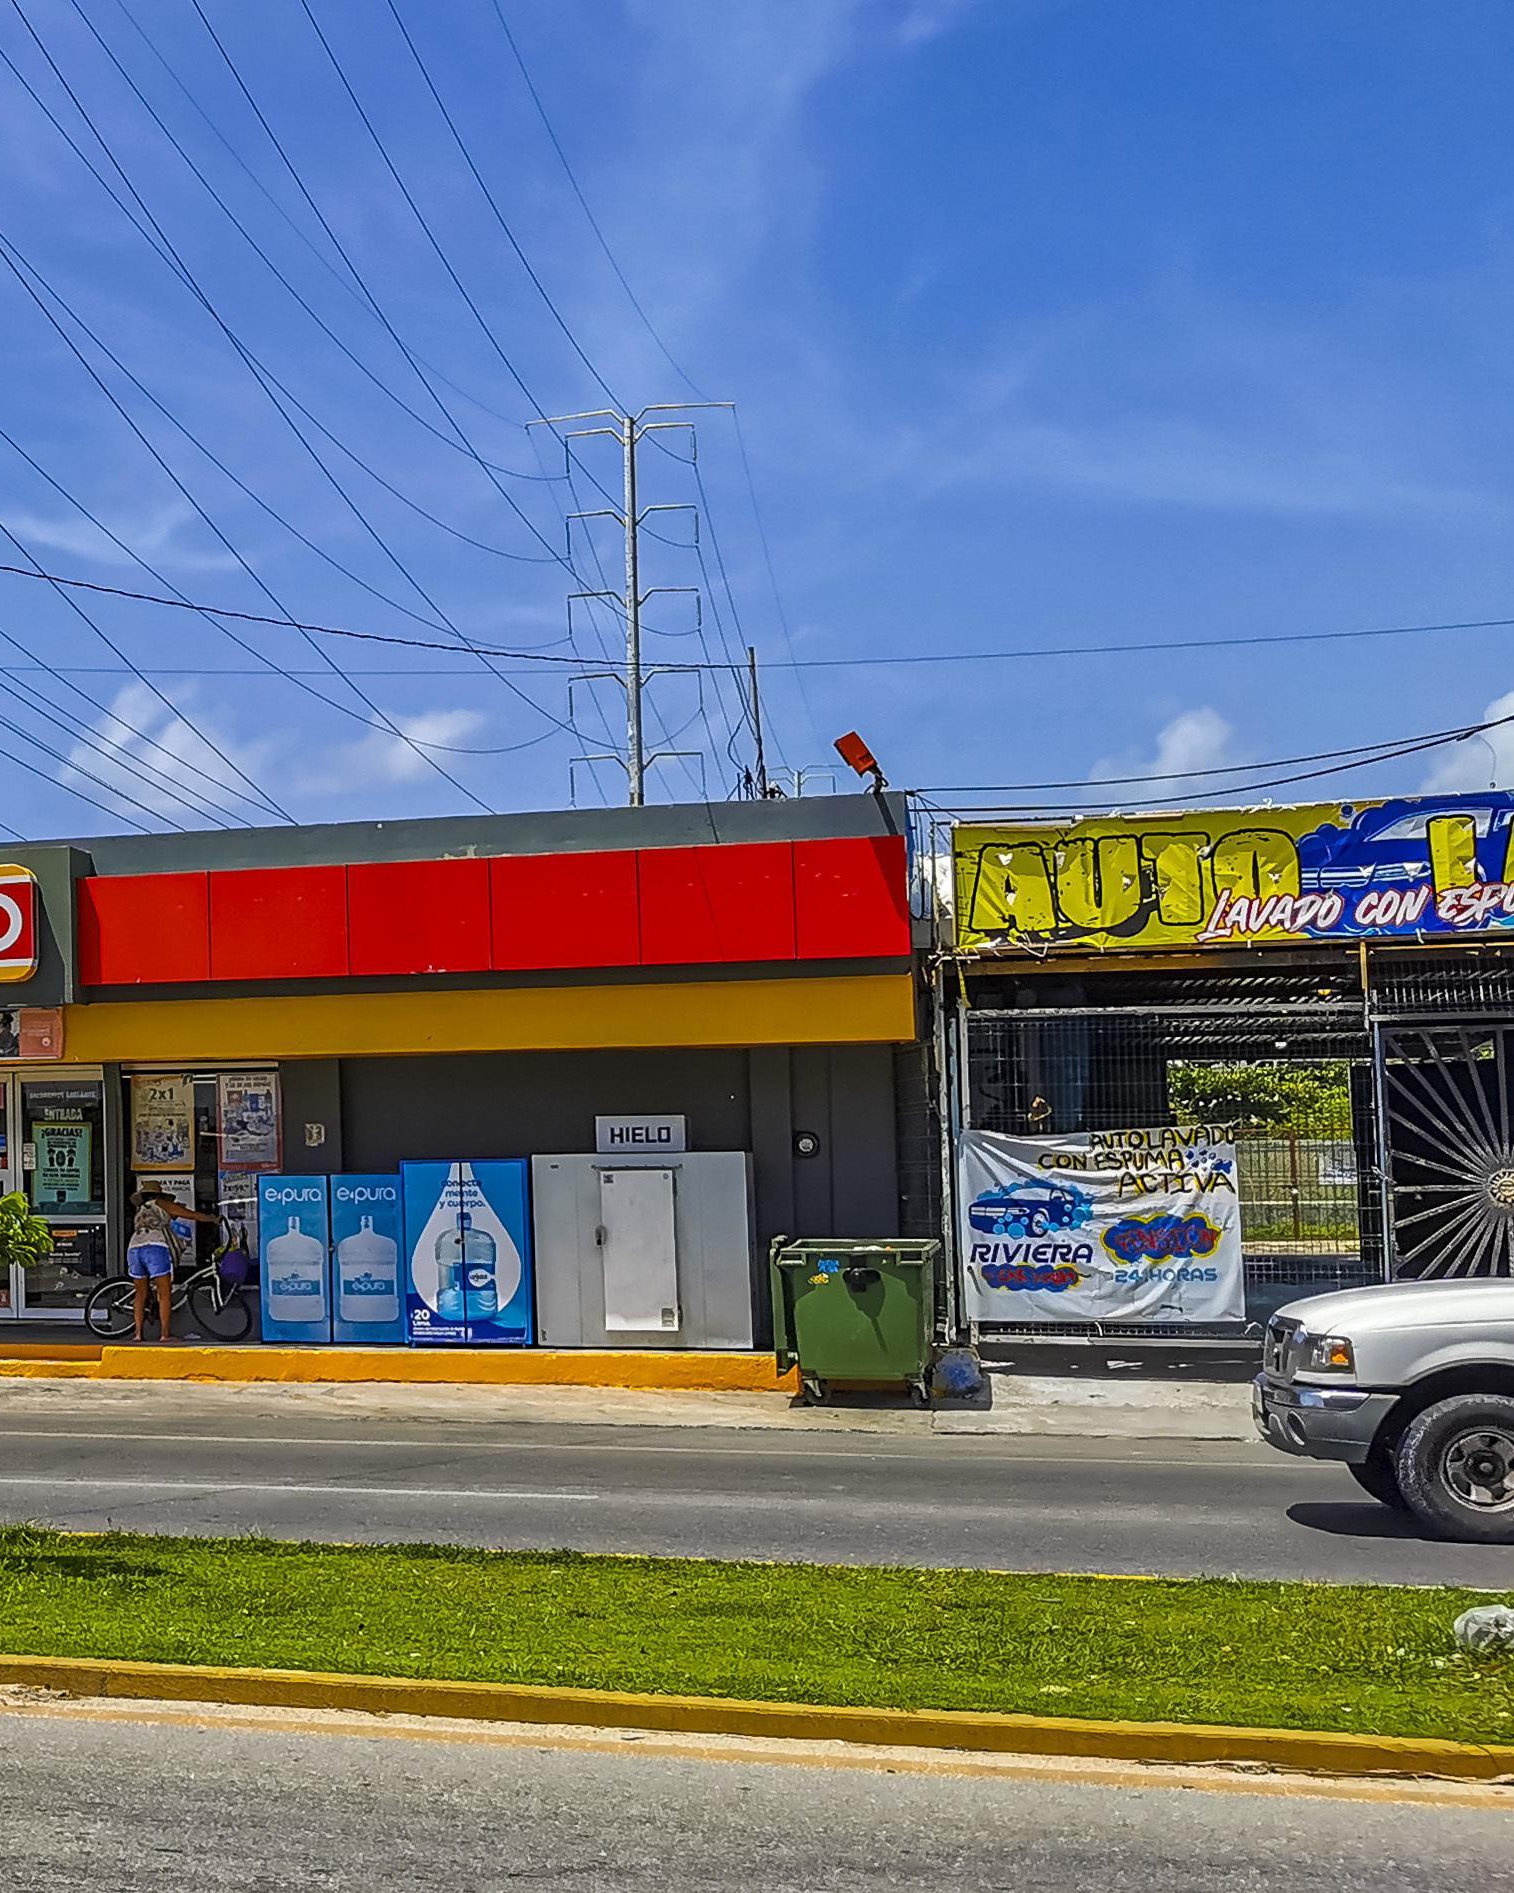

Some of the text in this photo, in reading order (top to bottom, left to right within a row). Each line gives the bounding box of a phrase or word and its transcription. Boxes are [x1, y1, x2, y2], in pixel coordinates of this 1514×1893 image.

[971, 827, 1303, 932] AUTO
[1196, 887, 1343, 942] LAVADO
[1354, 884, 1431, 927] CON
[609, 1126, 671, 1144] HIELO
[1037, 1149, 1185, 1171] CON ESPUMA
[1118, 1171, 1237, 1197] ACTIVA
[969, 1243, 1094, 1263] RIVIERA
[1147, 1268, 1218, 1283] HORAS
[413, 1309, 431, 1321] 20
